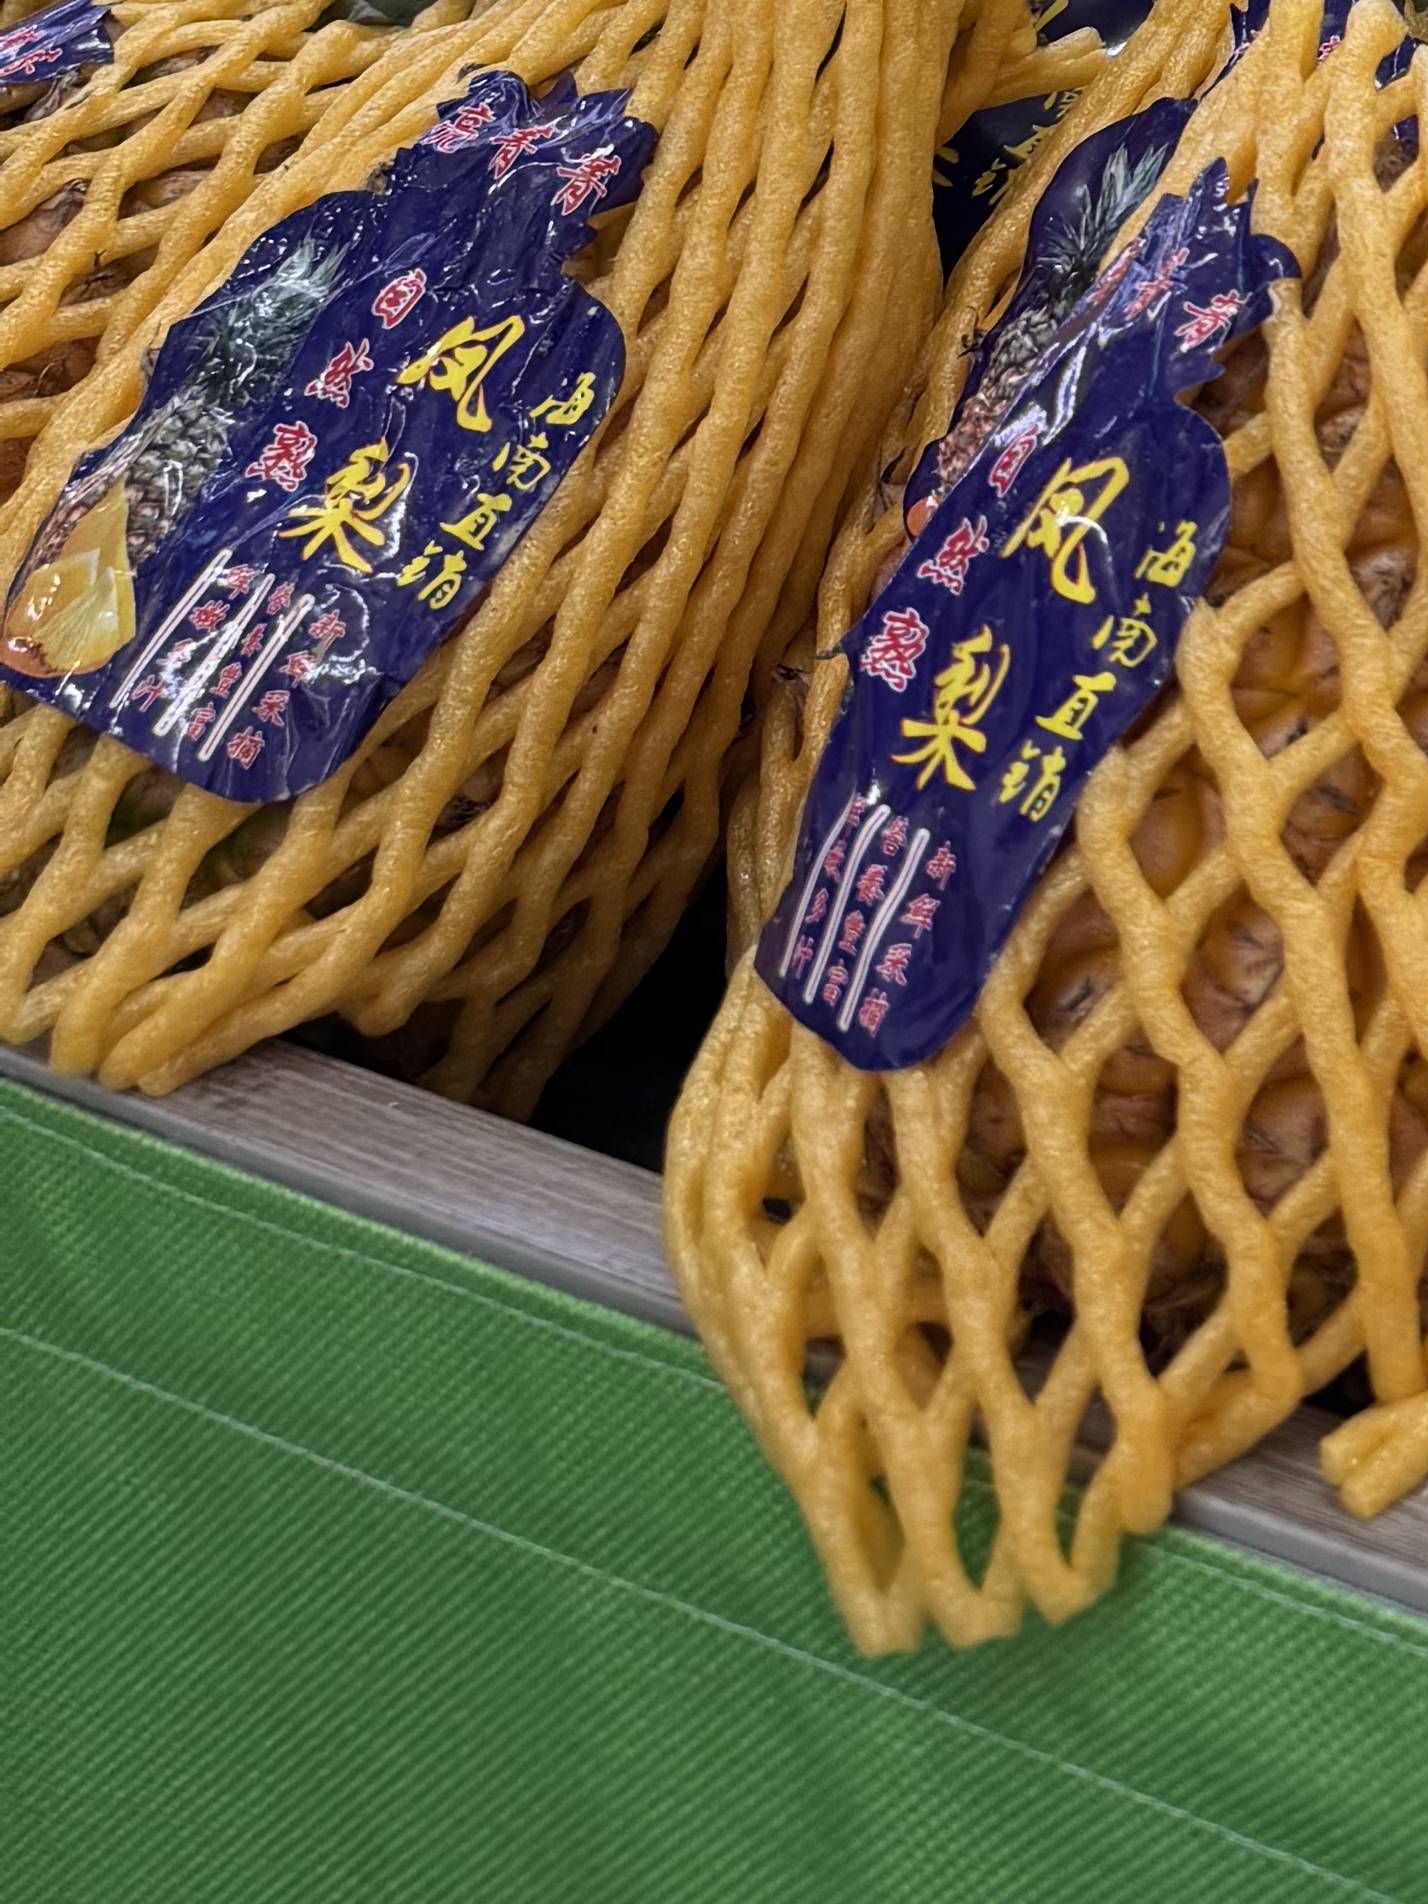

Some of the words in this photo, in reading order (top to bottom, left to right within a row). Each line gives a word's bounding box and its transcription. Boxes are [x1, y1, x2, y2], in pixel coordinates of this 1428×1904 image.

[246, 268, 427, 492] 自然熟
[280, 315, 526, 573] 凤梨
[397, 372, 596, 609] 海南直销
[858, 424, 1040, 692] 自然熟
[891, 456, 1130, 791] 凤梨
[999, 520, 1195, 822] 海南直销
